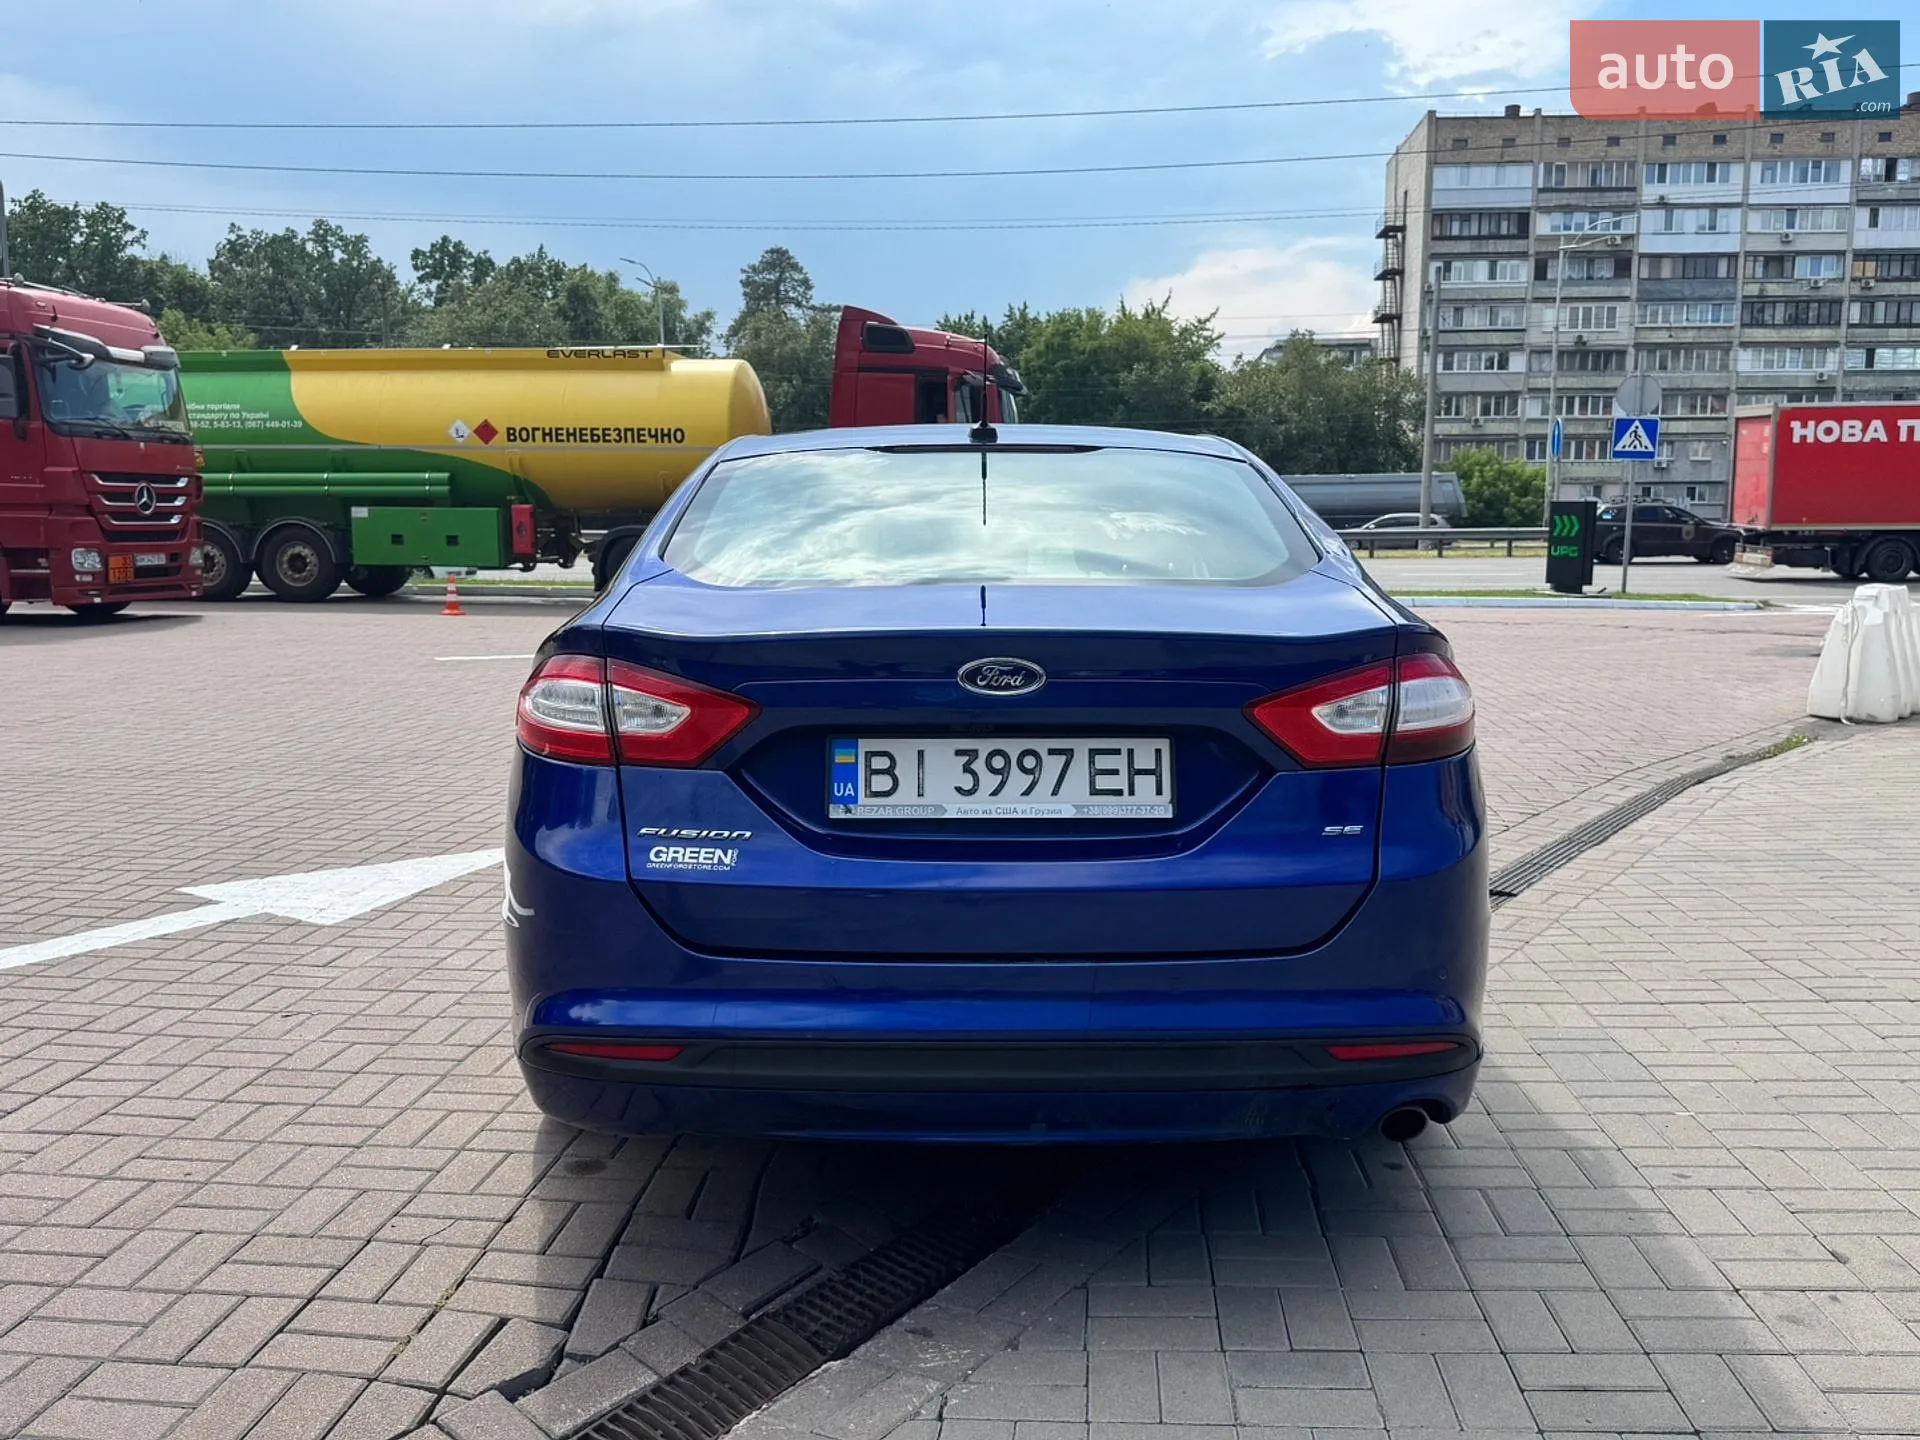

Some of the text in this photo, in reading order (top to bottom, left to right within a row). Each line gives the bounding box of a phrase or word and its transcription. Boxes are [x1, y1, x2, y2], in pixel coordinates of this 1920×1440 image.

[546, 349, 653, 359] EVERLAST
[506, 426, 685, 444] ВОГНЕНЕБЕЗПЕЧНО
[1790, 419, 1888, 443] НОВА
[1551, 545, 1579, 557] UPG
[977, 665, 1026, 686] Ford
[834, 783, 855, 797] UA
[638, 827, 753, 841] FUSION
[1321, 825, 1364, 836] SE
[649, 846, 733, 865] GREEN
